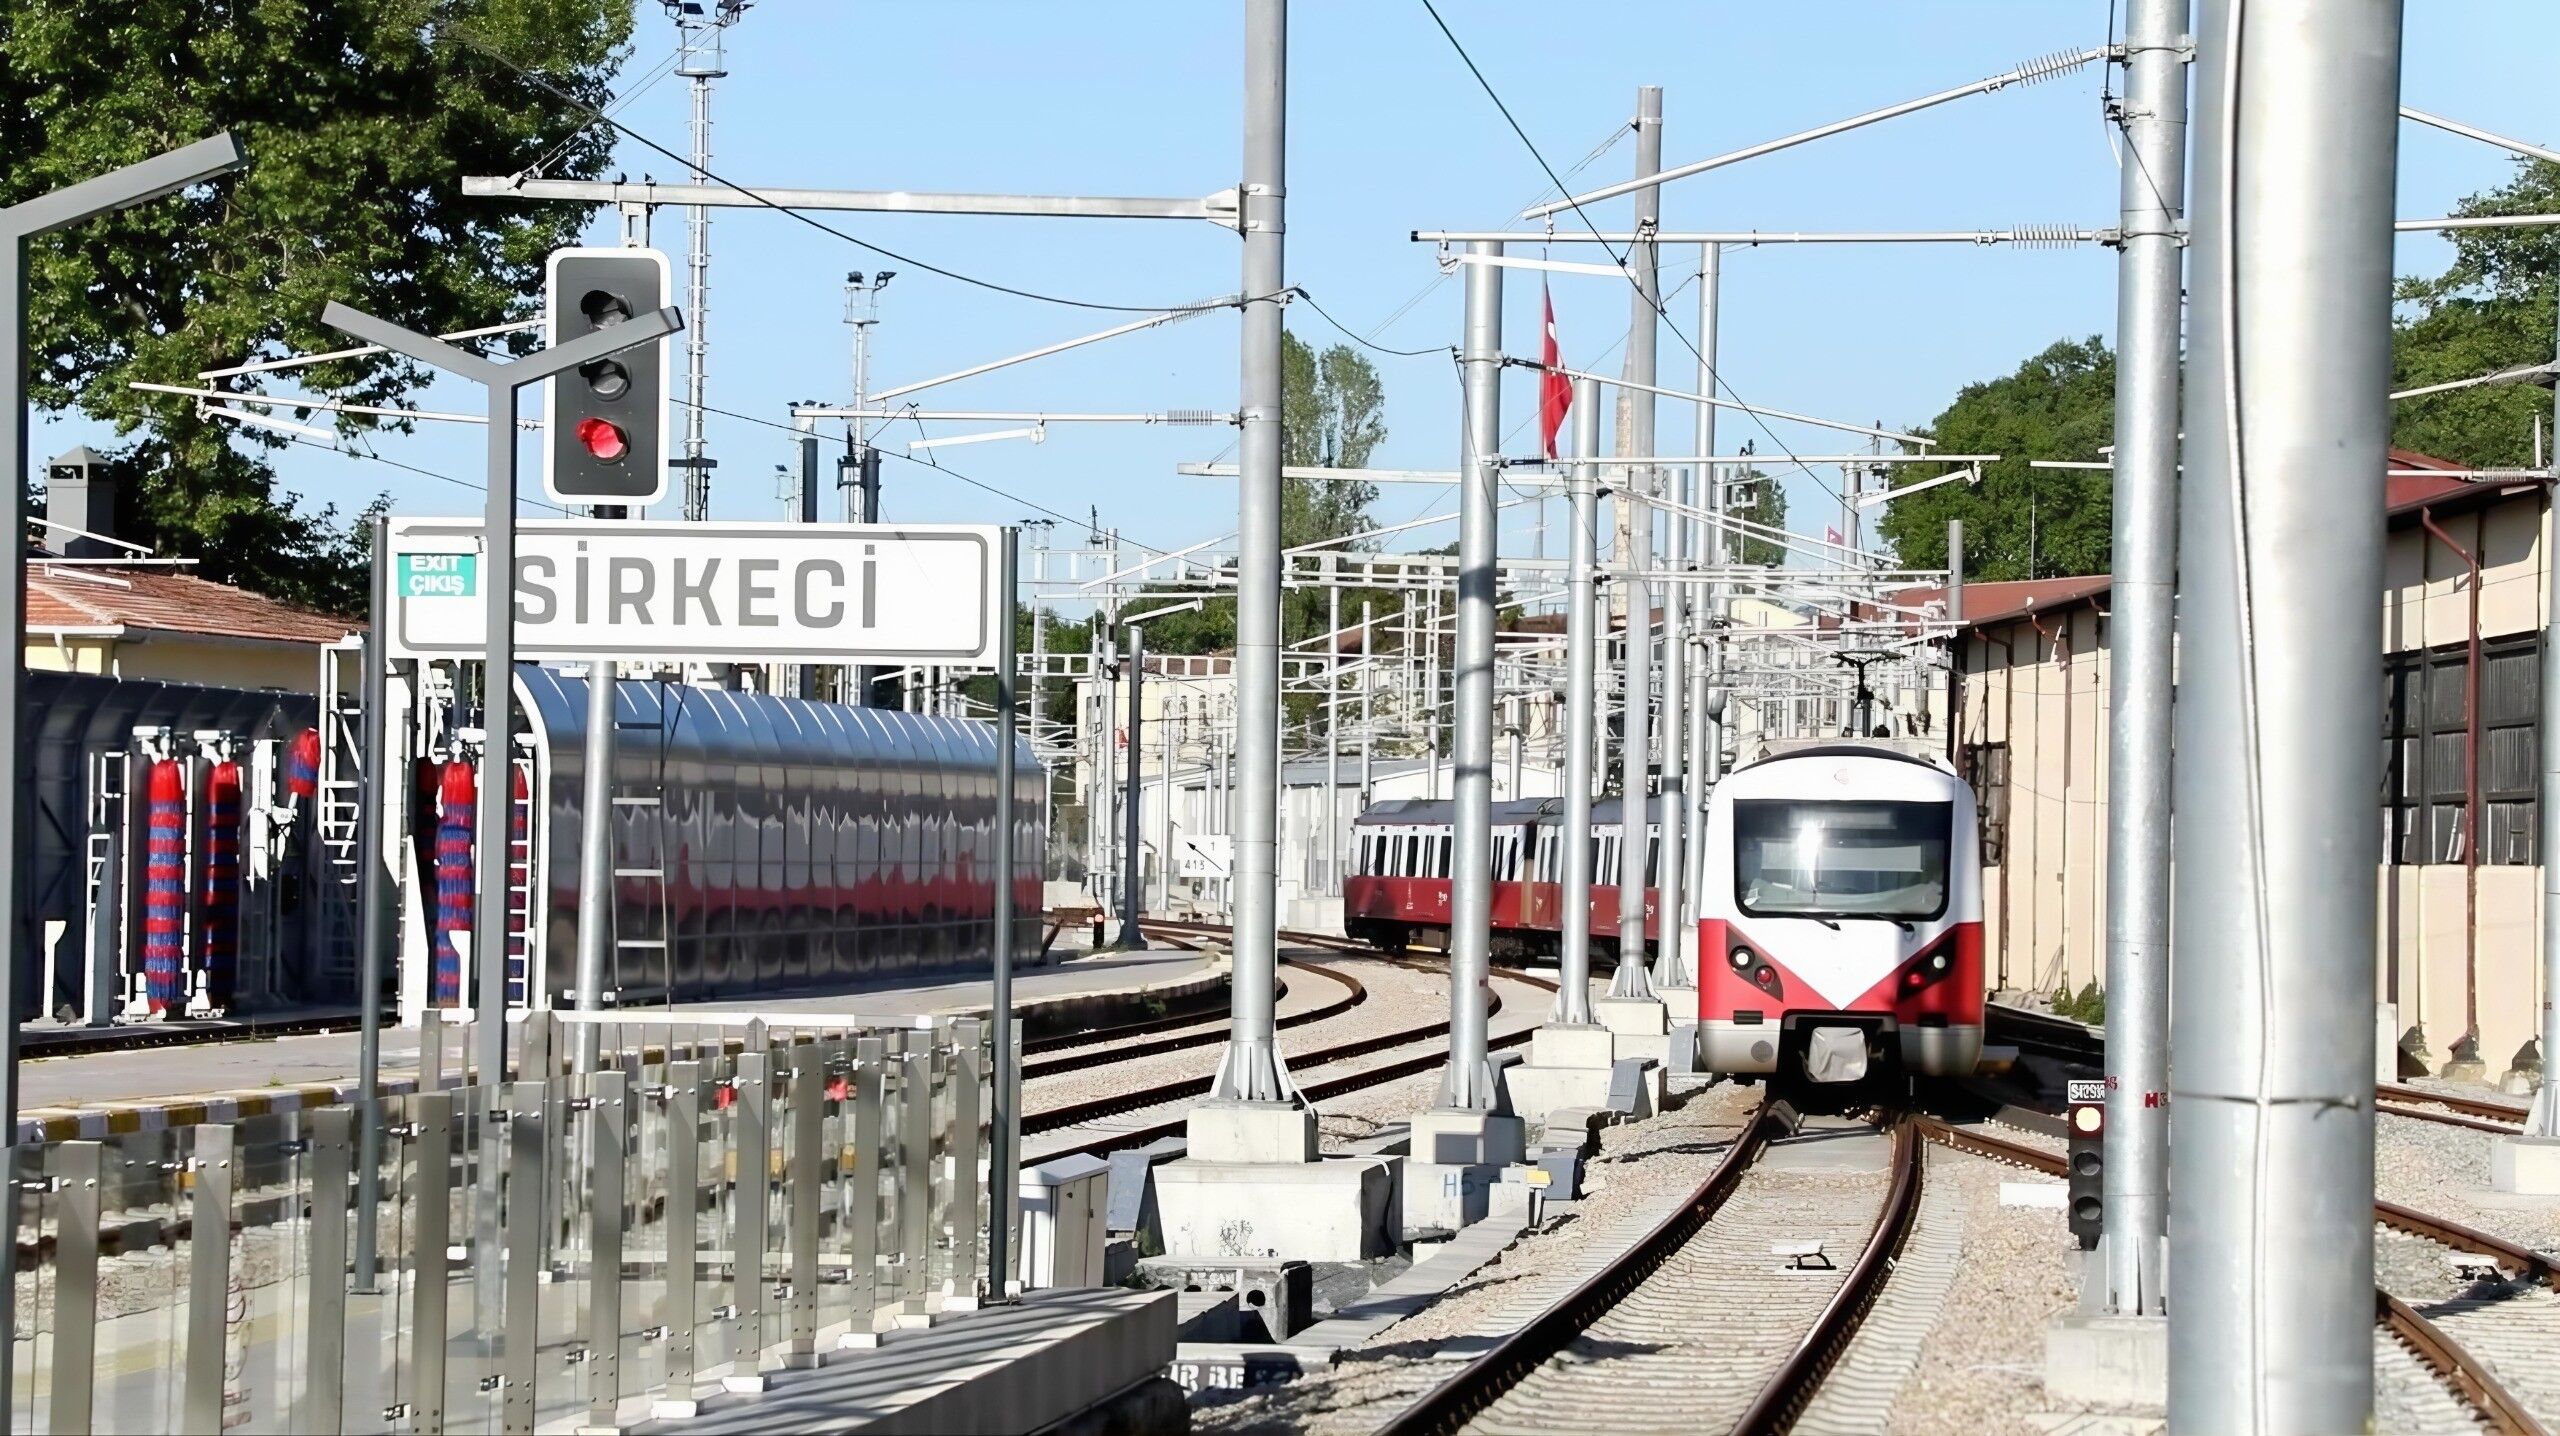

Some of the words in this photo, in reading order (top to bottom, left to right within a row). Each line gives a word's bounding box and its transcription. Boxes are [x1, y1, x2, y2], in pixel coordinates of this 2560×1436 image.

[410, 555, 462, 572] EXIT
[409, 574, 465, 596] ÇIKIŞ
[514, 541, 876, 629] SİRKECİ
